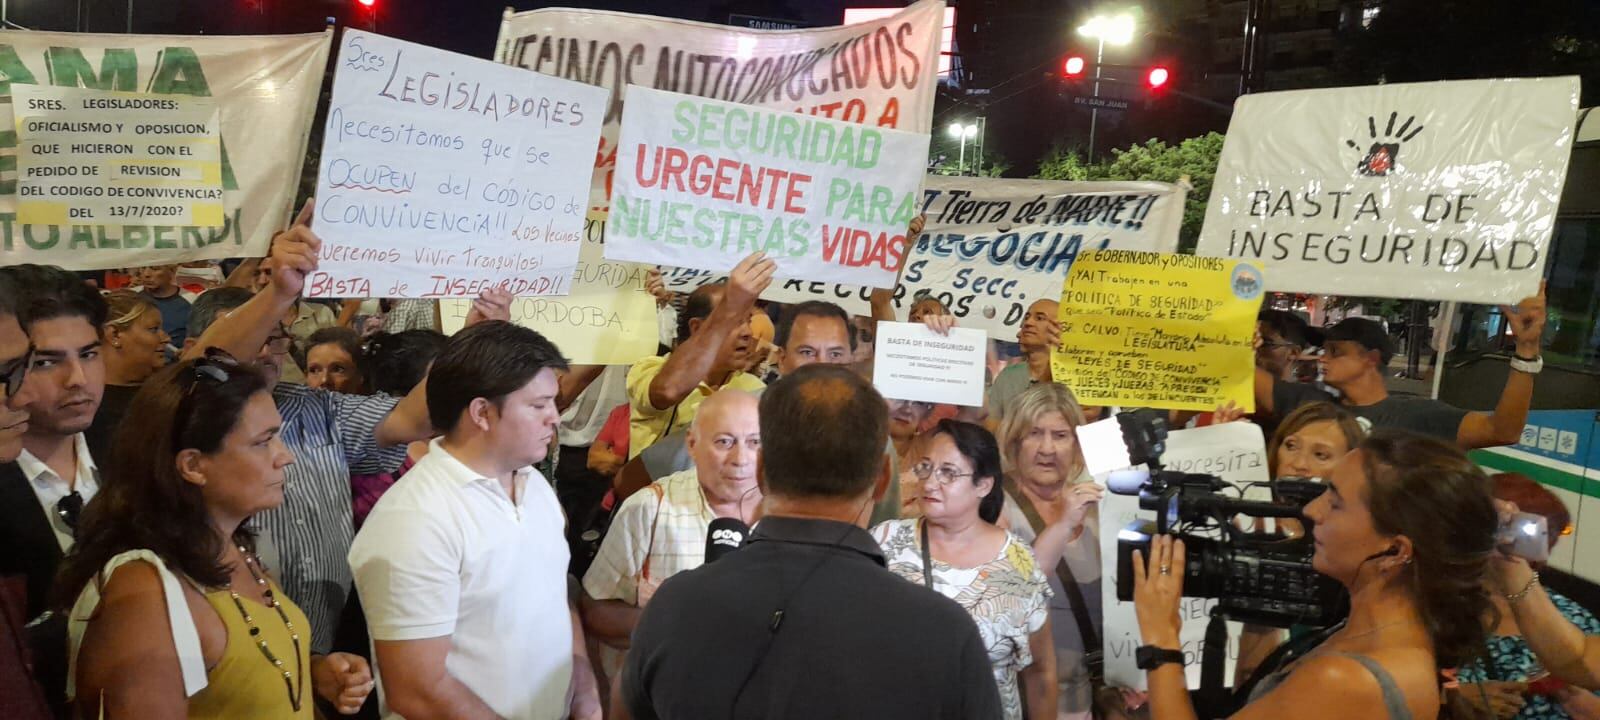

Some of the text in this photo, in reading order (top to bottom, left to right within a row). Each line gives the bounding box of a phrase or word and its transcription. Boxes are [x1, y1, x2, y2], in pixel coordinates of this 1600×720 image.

[28, 98, 179, 110] SRES. LEGISLADORES:
[28, 121, 210, 135] OFICIALISMO Y OPOSICION,
[672, 100, 883, 170] SEGURIDAD
[31, 143, 193, 156] QUE HICIERON CON EL
[482, 138, 513, 167] que
[527, 147, 551, 165] se
[27, 165, 181, 177] PEDIDO DE REVISION
[635, 144, 812, 214] URGENTE
[20, 186, 223, 199] DEL CODIGO DE CONVIVENCIA?
[328, 159, 417, 191] OCUPEN
[438, 175, 471, 199] del
[564, 197, 580, 217] de
[69, 206, 183, 218] DEL 13/7/2020?
[825, 179, 915, 227] PARA
[936, 189, 1011, 225] Tierra
[1013, 194, 1048, 224] de
[1249, 190, 1477, 225] BASTA DE
[611, 194, 811, 258] NUESTRAS
[821, 223, 908, 272] VIDAS
[1094, 249, 1160, 265] GOBERNADOR
[1170, 254, 1225, 272] OPOSITORES
[1227, 229, 1539, 270] INSEGURIDAD
[309, 271, 372, 297] BASTA
[388, 282, 409, 297] de
[573, 262, 655, 291] GURIDA
[952, 267, 1026, 301] Secc.
[1082, 322, 1120, 336] CALVO
[886, 337, 976, 352] BASTA DE INSEGURIDAD
